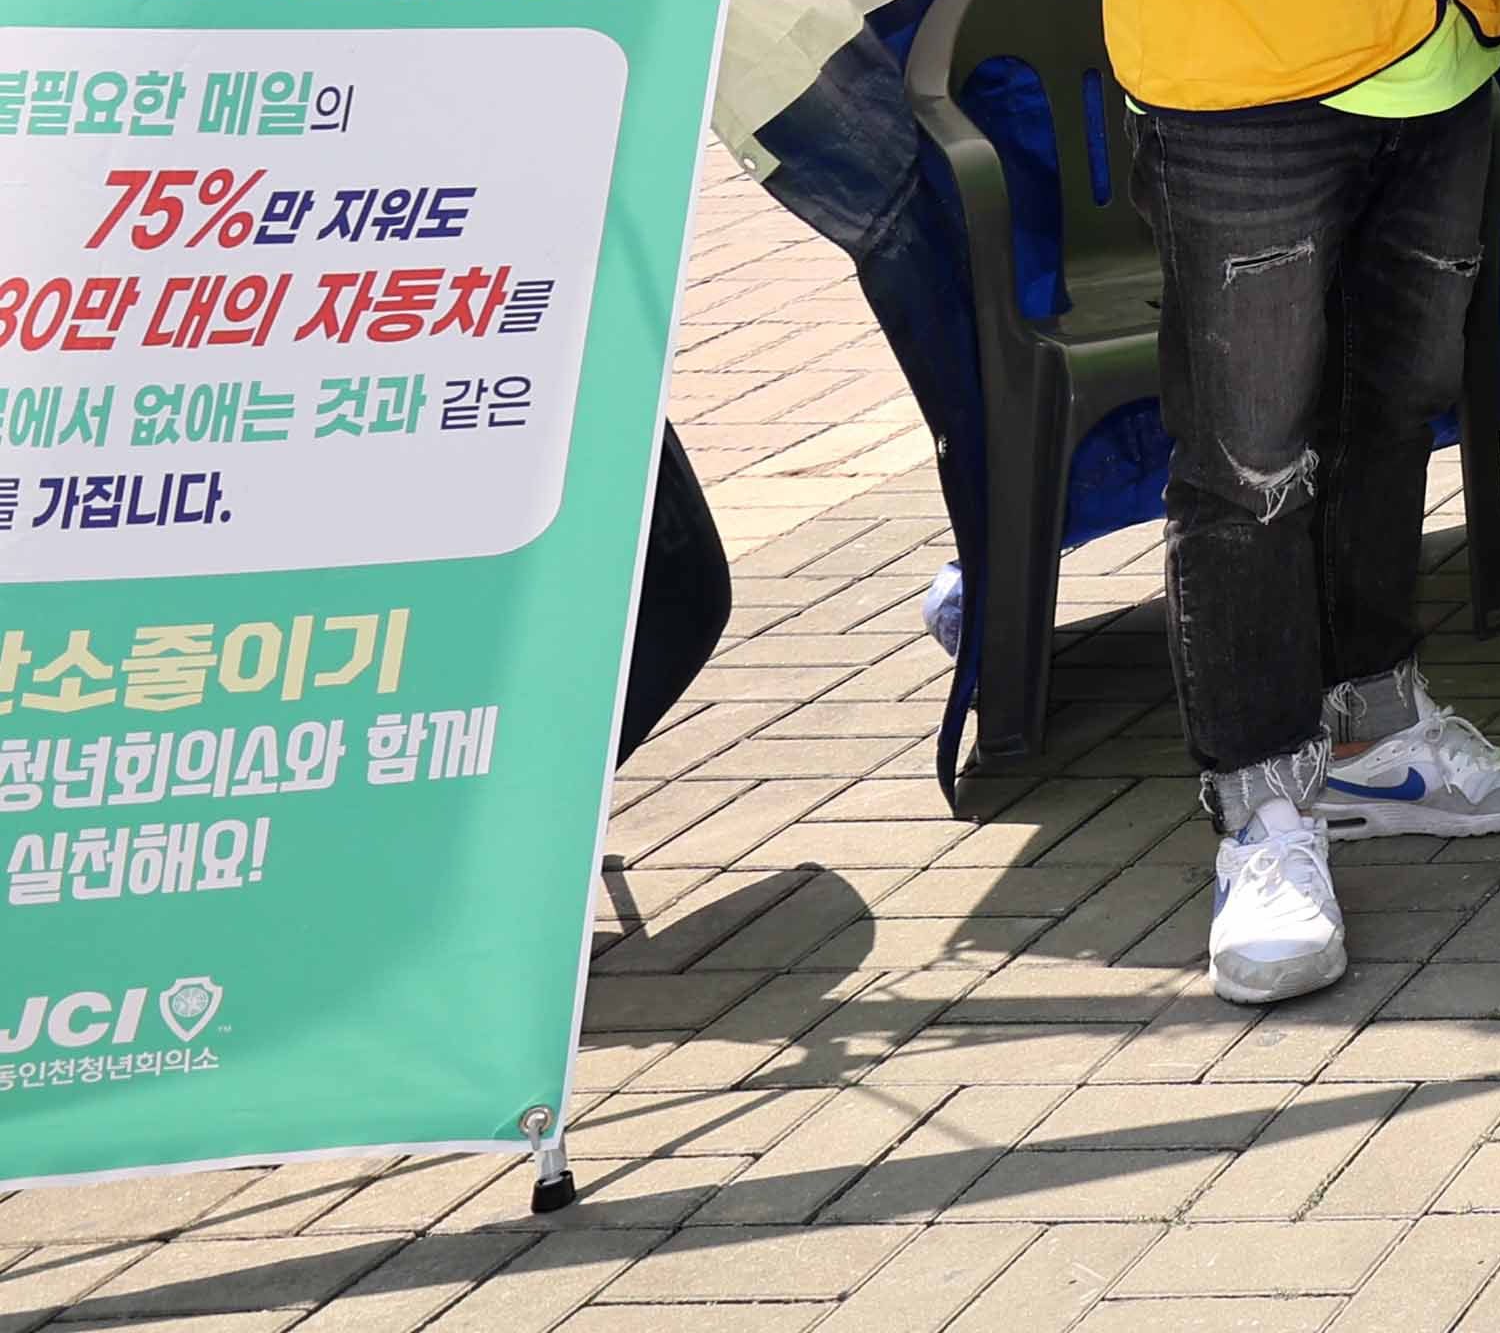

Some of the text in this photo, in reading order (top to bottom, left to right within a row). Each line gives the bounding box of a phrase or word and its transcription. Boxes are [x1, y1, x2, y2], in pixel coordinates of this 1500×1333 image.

[197, 70, 355, 136] 메일의
[84, 167, 477, 250] 75%만 지워도
[141, 271, 290, 348] 대의
[294, 265, 555, 344] 자동차를
[130, 380, 296, 448] 없애는
[313, 375, 428, 445] 것과
[440, 375, 534, 431] 같은
[32, 471, 233, 530] 가집니다.
[366, 705, 499, 786] 함께
[7, 816, 271, 906] 실천해요!
[0, 987, 148, 1046] JCI
